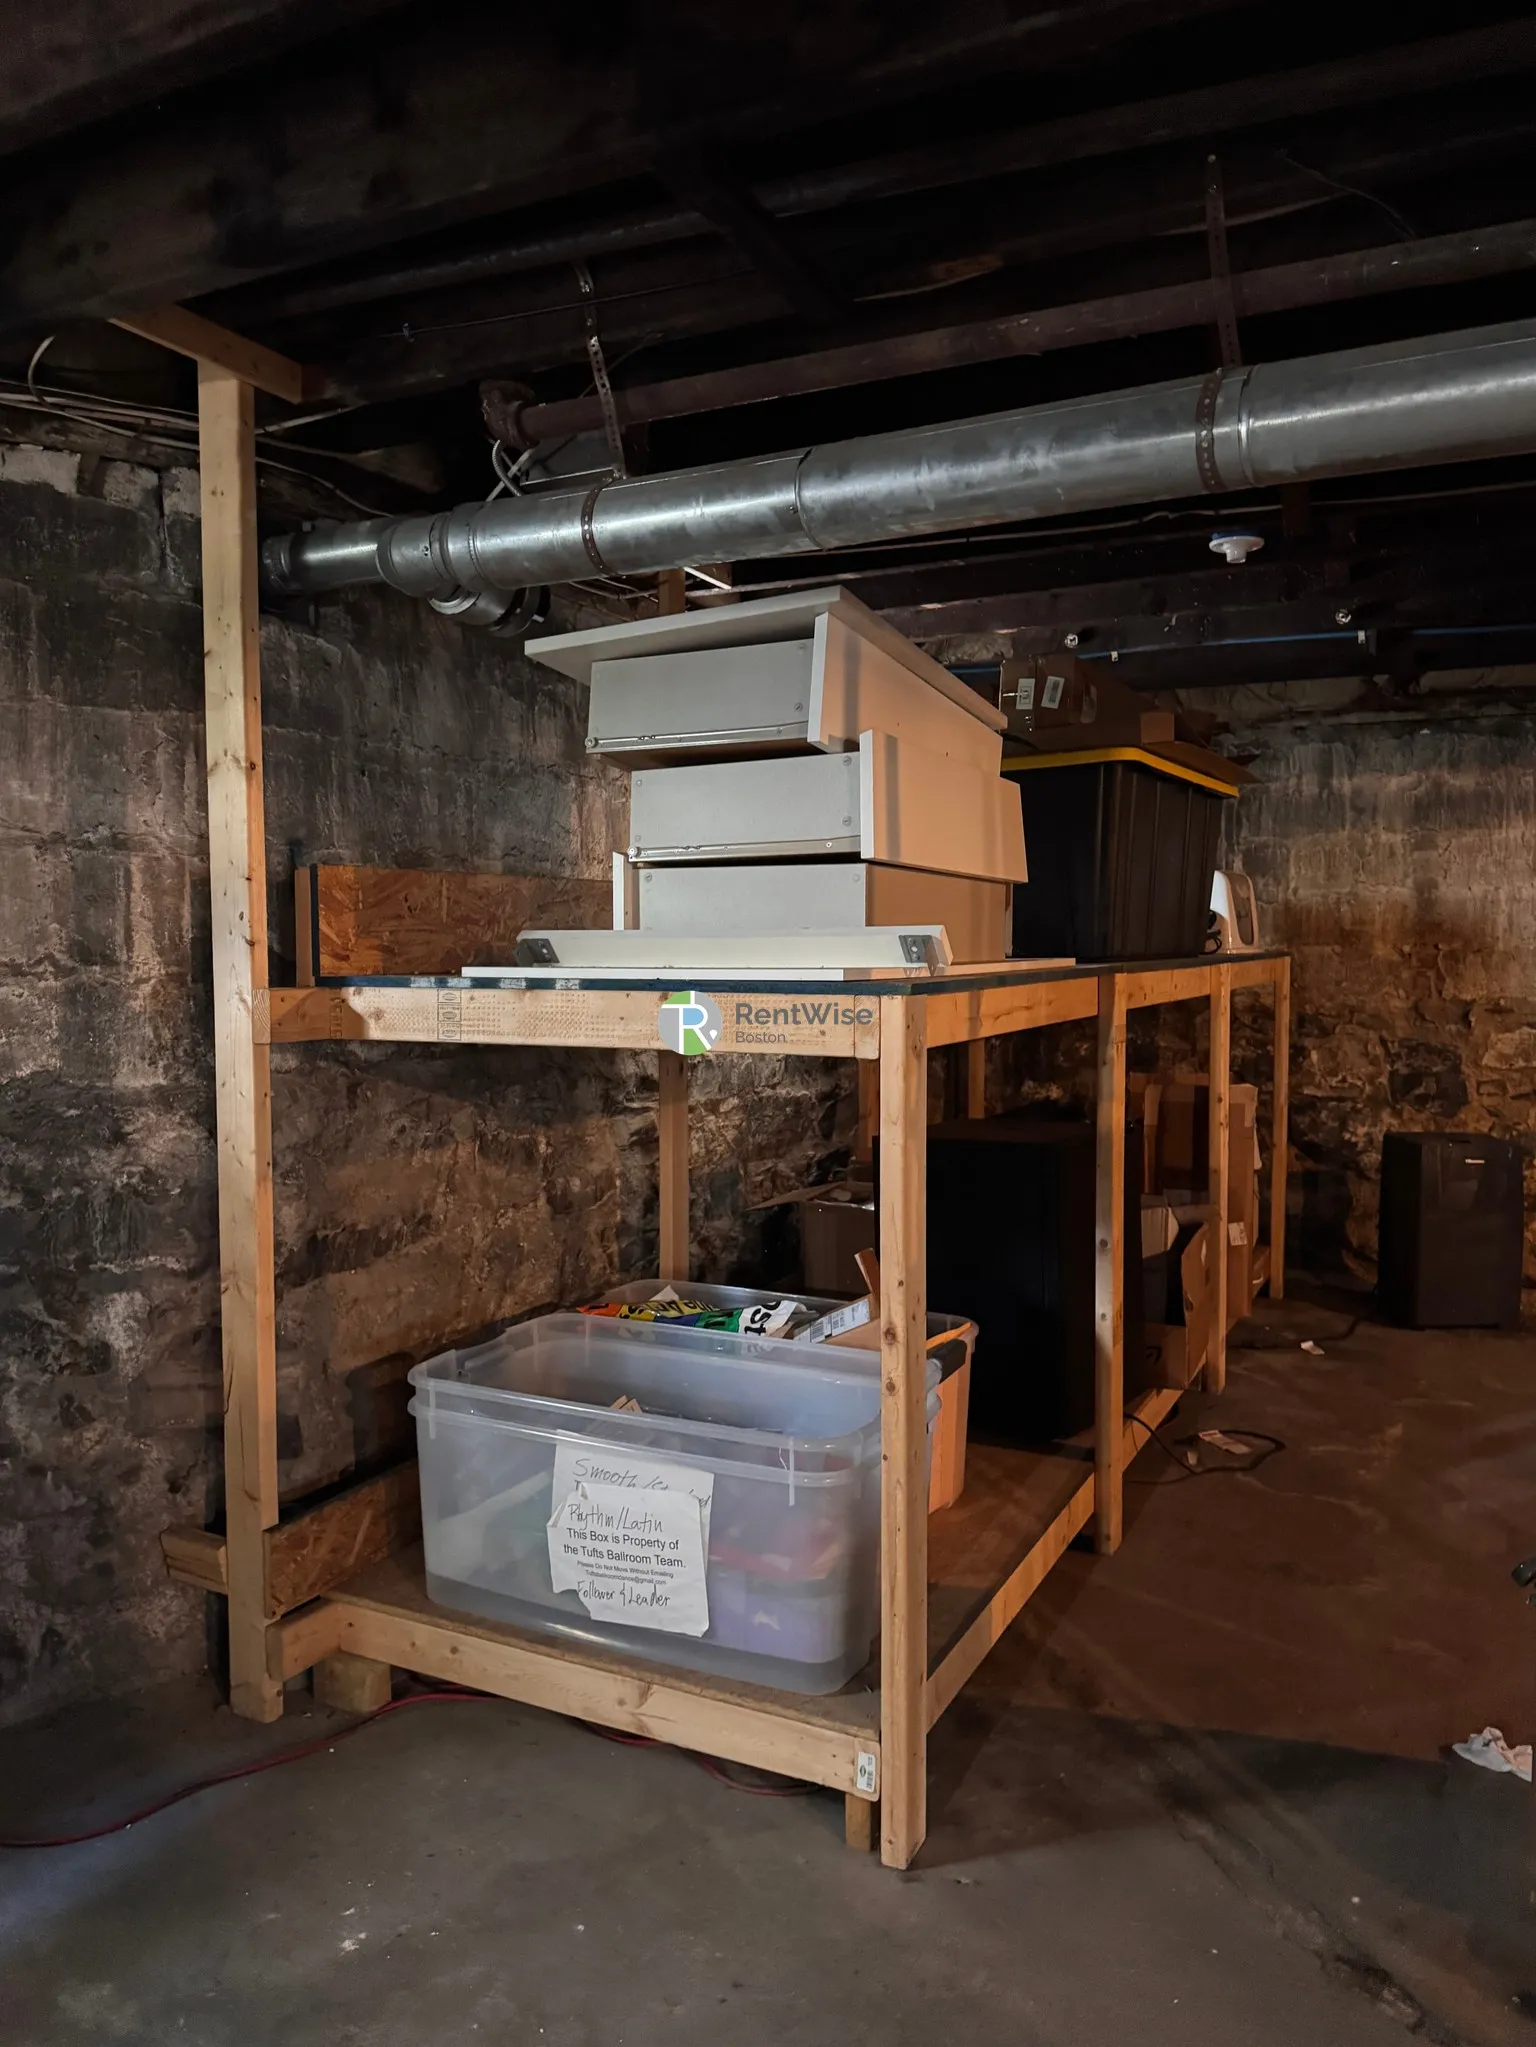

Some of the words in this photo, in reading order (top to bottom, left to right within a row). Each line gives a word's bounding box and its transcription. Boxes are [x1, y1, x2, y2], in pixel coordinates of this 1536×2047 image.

[573, 1458, 638, 1488] Smooth
[566, 1527, 587, 1540] This
[589, 1530, 609, 1543] Box
[611, 1533, 620, 1544] is
[622, 1534, 666, 1551] Property
[668, 1538, 679, 1550] of
[563, 1543, 579, 1555] the
[580, 1545, 604, 1559] Tufts
[606, 1549, 652, 1564] Ballroom
[653, 1554, 686, 1568] Team.
[613, 1565, 628, 1573] Move
[629, 1567, 650, 1575] Without
[650, 1570, 674, 1579] Emailing
[577, 1579, 615, 1600] Follower
[628, 1583, 671, 1607] Leader
